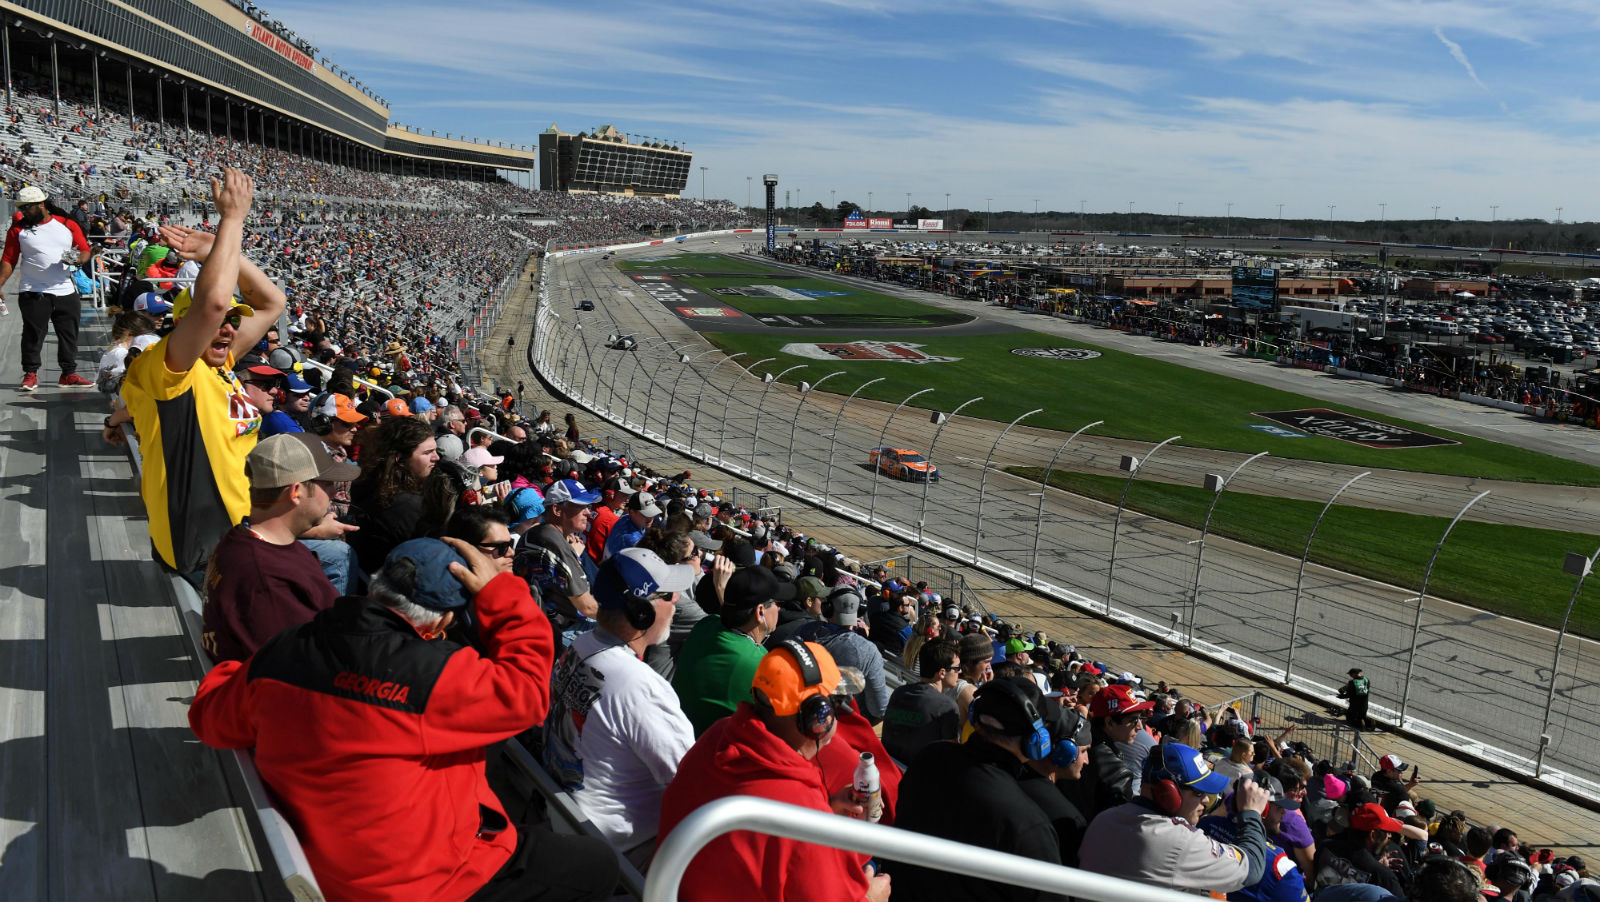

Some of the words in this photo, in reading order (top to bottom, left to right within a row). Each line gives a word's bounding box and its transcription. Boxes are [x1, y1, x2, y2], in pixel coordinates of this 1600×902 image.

[251, 24, 275, 49] ATLANTA
[275, 39, 292, 59] MOTOR
[292, 50, 314, 71] SPEEDWAY
[333, 671, 410, 703] GEORGIA
